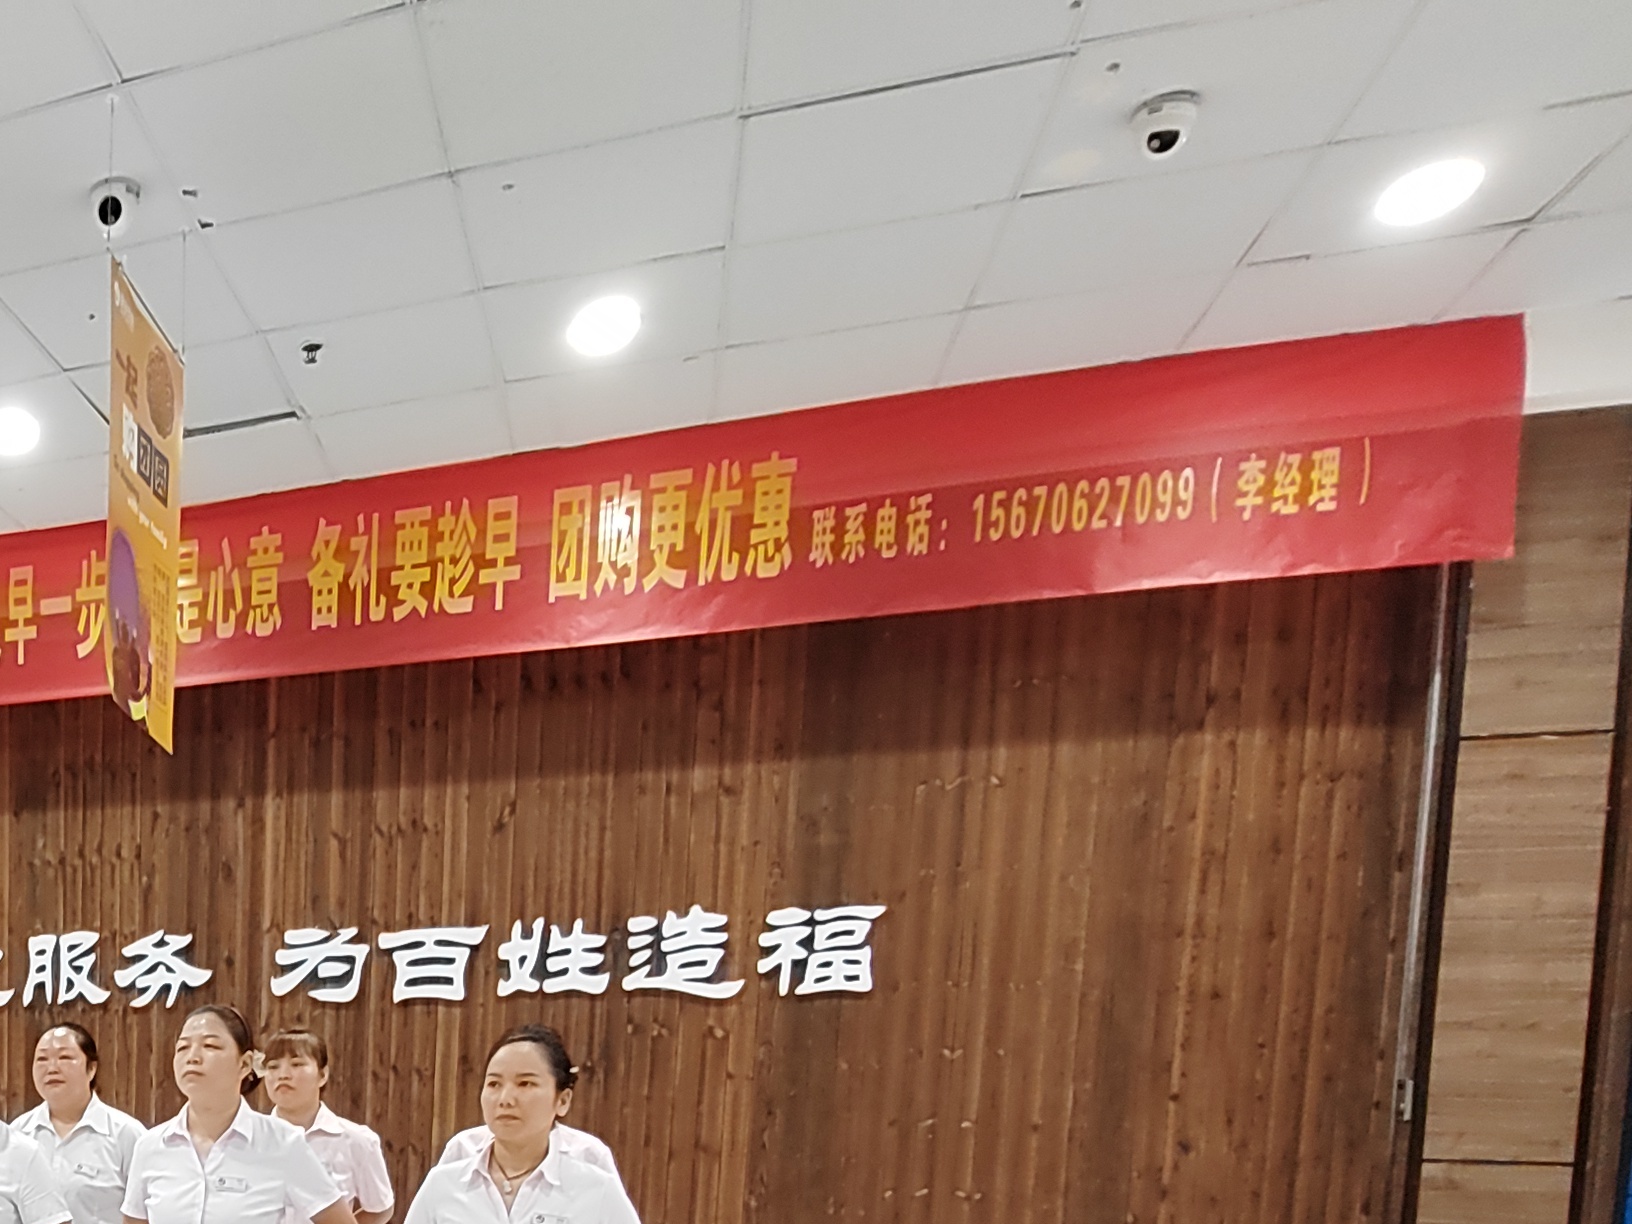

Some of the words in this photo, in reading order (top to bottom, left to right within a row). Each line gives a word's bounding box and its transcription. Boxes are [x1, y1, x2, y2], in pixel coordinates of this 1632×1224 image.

[175, 526, 284, 644] 是心意
[307, 495, 521, 631] 备礼要趁早
[548, 451, 798, 604] 团购更优惠
[271, 904, 887, 1004] 为百姓造福
